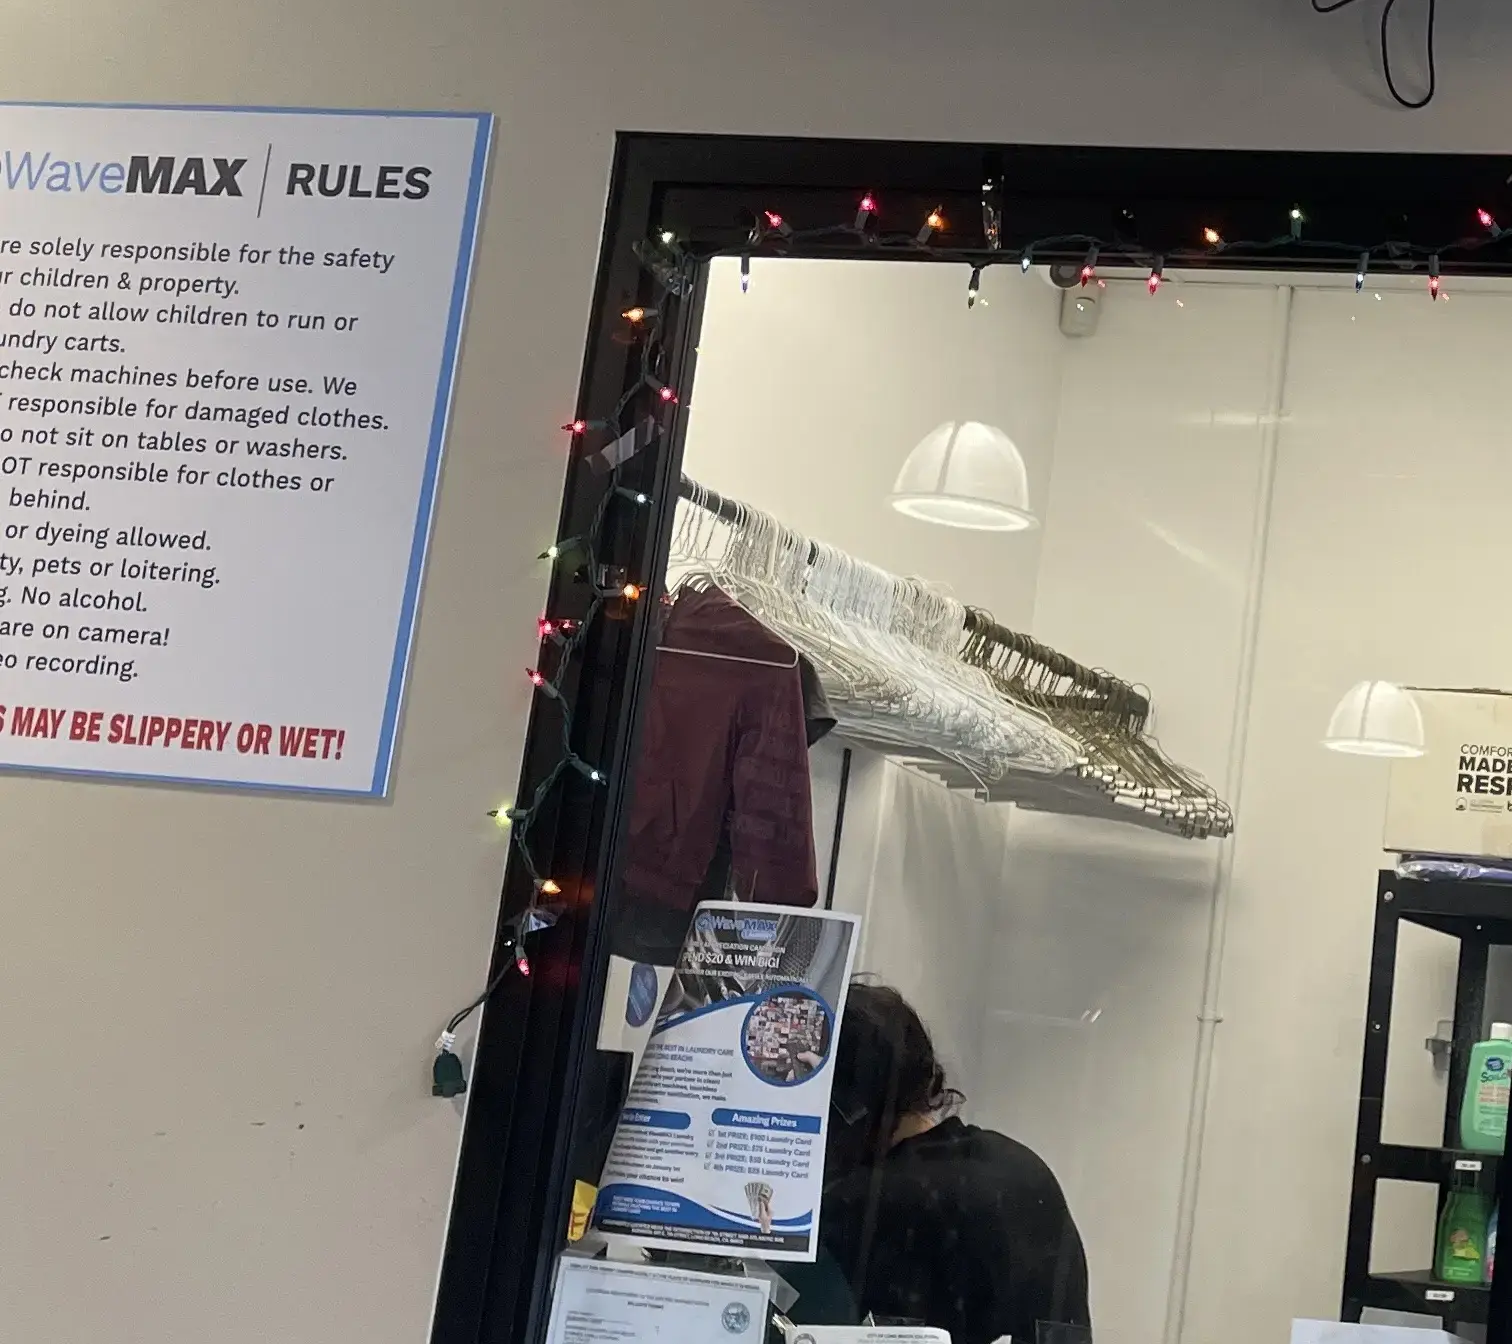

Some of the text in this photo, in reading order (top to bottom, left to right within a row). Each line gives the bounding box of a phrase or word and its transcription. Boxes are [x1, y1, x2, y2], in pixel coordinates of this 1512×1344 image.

[286, 164, 432, 199] RULES
[29, 237, 94, 261] solely
[101, 243, 230, 264] responsible
[239, 244, 271, 263] for
[279, 246, 314, 266] the
[323, 248, 395, 273] safety
[20, 268, 109, 289] children
[117, 272, 131, 290] &
[139, 277, 239, 298] property.
[9, 298, 358, 331] do not allow children to run or
[65, 335, 125, 353] carts.
[0, 360, 357, 396] check machines before use. We
[8, 396, 388, 430] responsible for damaged clothes.
[21, 428, 59, 445] not
[66, 427, 94, 447] sit
[102, 433, 128, 448] on
[138, 431, 207, 453] tables
[216, 438, 239, 454] or
[247, 438, 347, 460] washers.
[38, 462, 168, 483] responsible
[177, 465, 210, 485] for
[217, 467, 302, 490] clothes
[310, 477, 334, 492] or
[9, 487, 90, 510] behind.
[6, 521, 211, 551] or dyeing allowed.
[32, 557, 81, 578] pets
[89, 563, 113, 577] or
[120, 558, 220, 588] loitering.
[22, 586, 51, 606] No
[59, 588, 147, 612] alcohol.
[0, 621, 169, 647] are on camera!
[26, 655, 138, 682] recording.
[11, 707, 66, 738] MAY
[69, 711, 104, 742] BE
[107, 714, 232, 751] SLIPPERY
[237, 723, 272, 754] OR
[278, 726, 345, 760] WET!
[725, 954, 732, 965] &
[735, 955, 756, 967] WIN
[732, 1113, 797, 1128] Amazing Prizes
[765, 1147, 792, 1156] Laundry
[767, 1135, 794, 1145] Laundry
[762, 1168, 789, 1178] Laundry
[763, 1157, 809, 1168] Laundry Card
